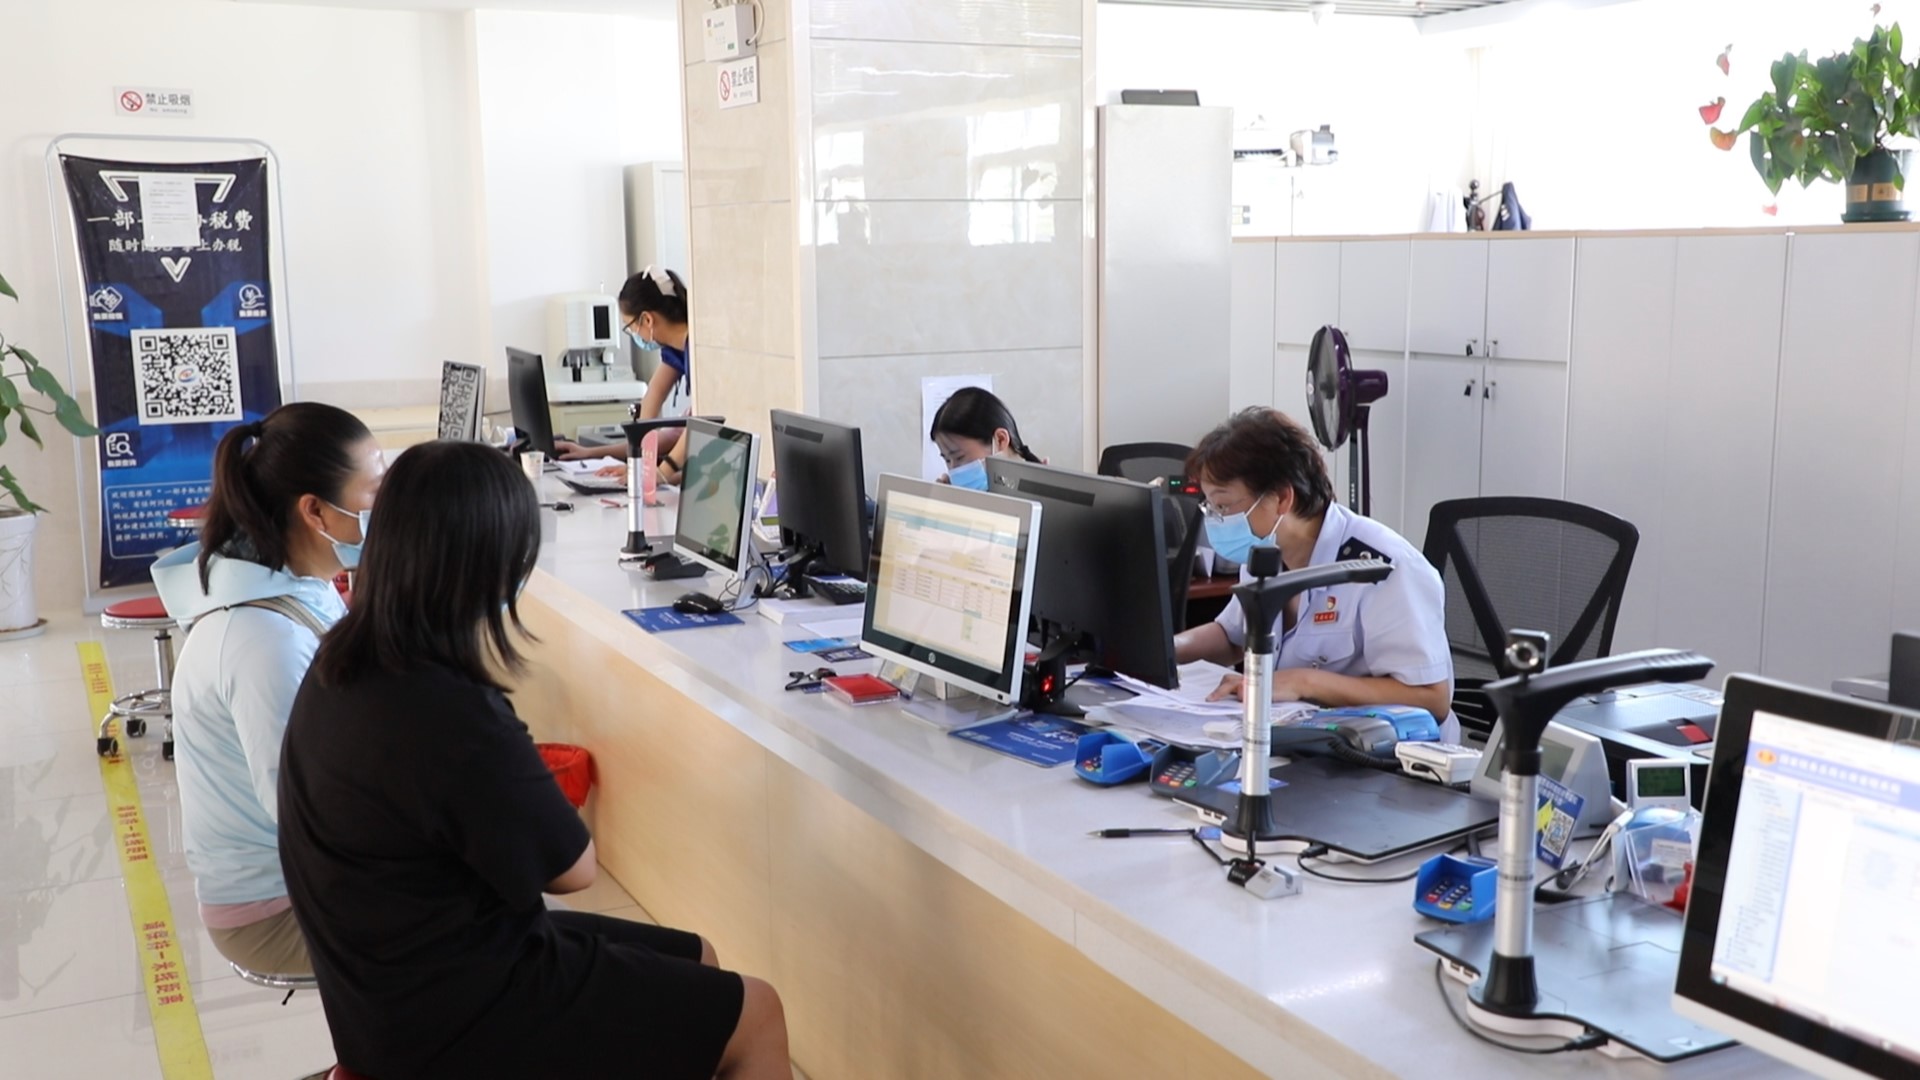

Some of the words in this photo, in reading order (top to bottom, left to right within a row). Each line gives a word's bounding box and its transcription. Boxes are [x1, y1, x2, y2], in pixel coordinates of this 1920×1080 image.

[146, 92, 191, 106] 禁止吸烟
[87, 208, 253, 231] 一部税费
